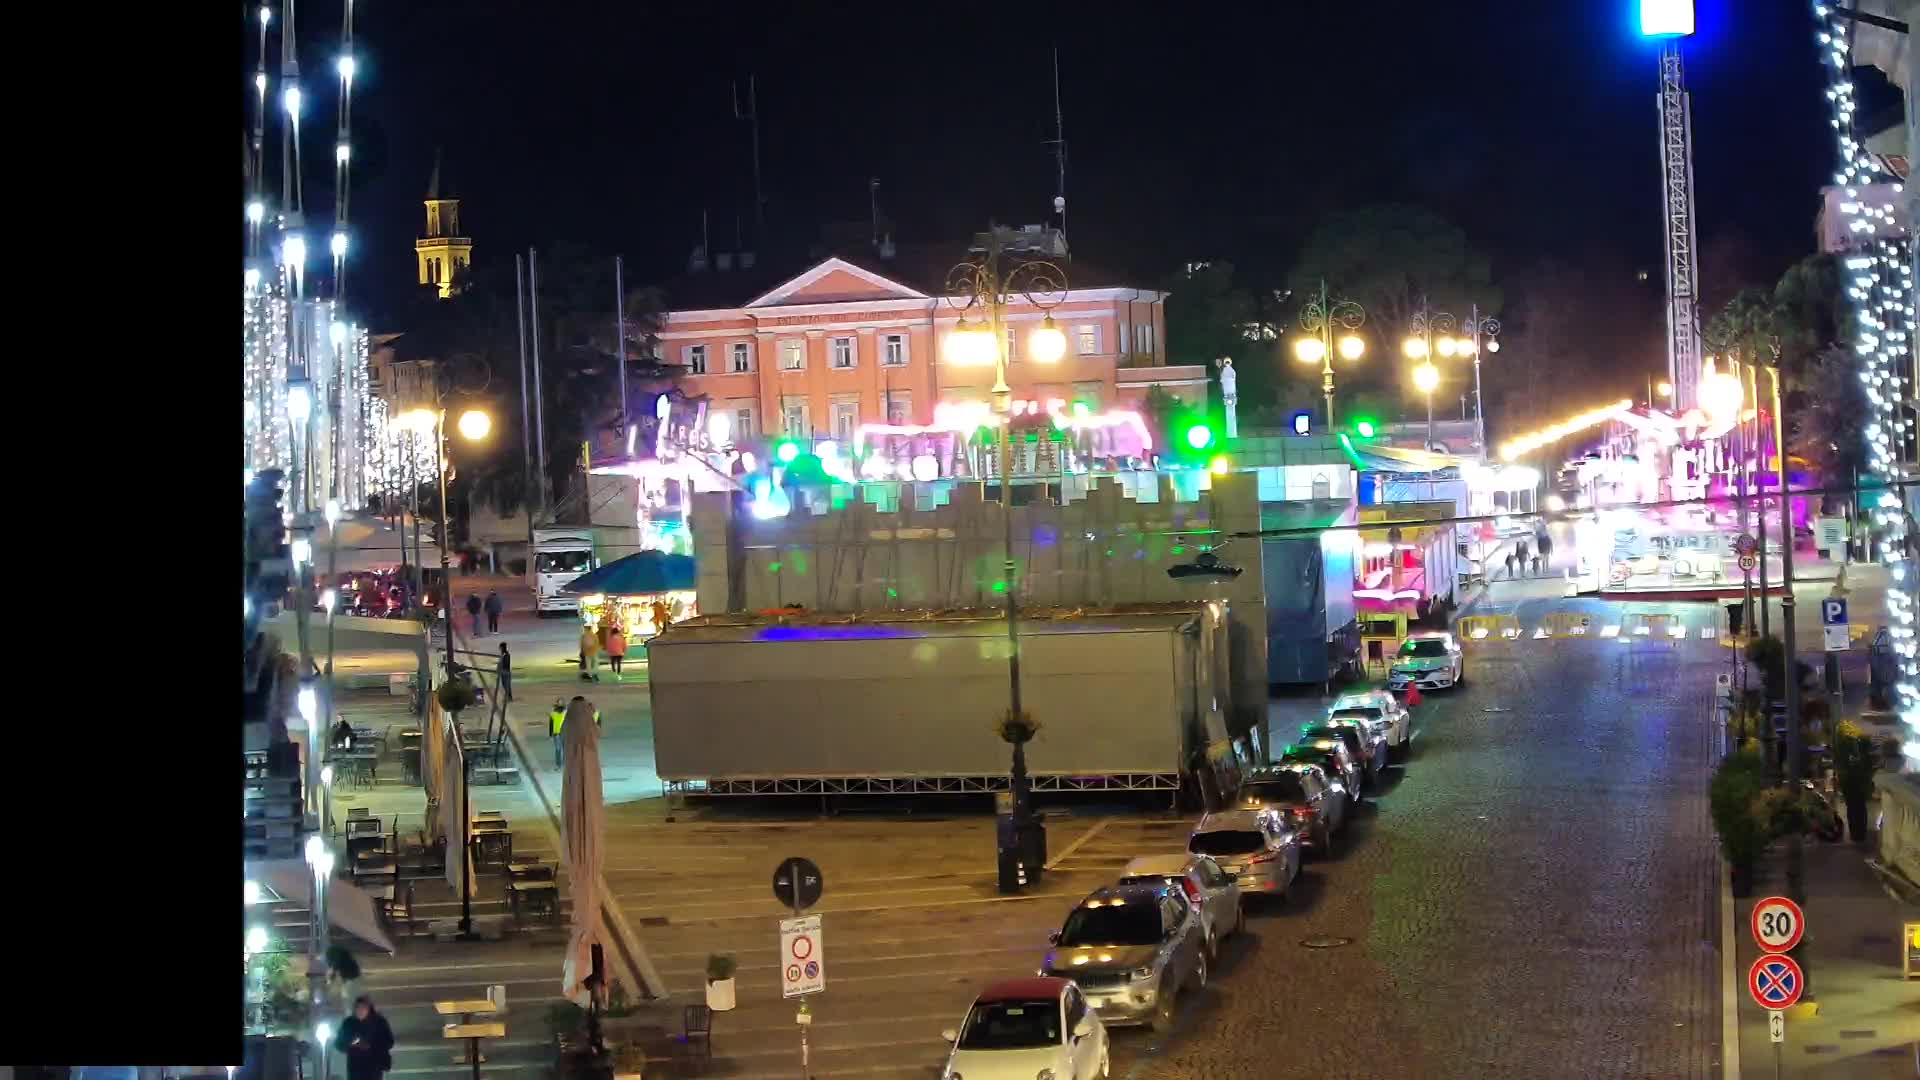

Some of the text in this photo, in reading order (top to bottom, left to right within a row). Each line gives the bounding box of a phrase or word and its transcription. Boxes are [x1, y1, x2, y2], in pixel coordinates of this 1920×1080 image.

[1742, 557, 1753, 567] 20
[1826, 602, 1842, 622] P
[1762, 912, 1791, 938] 30
